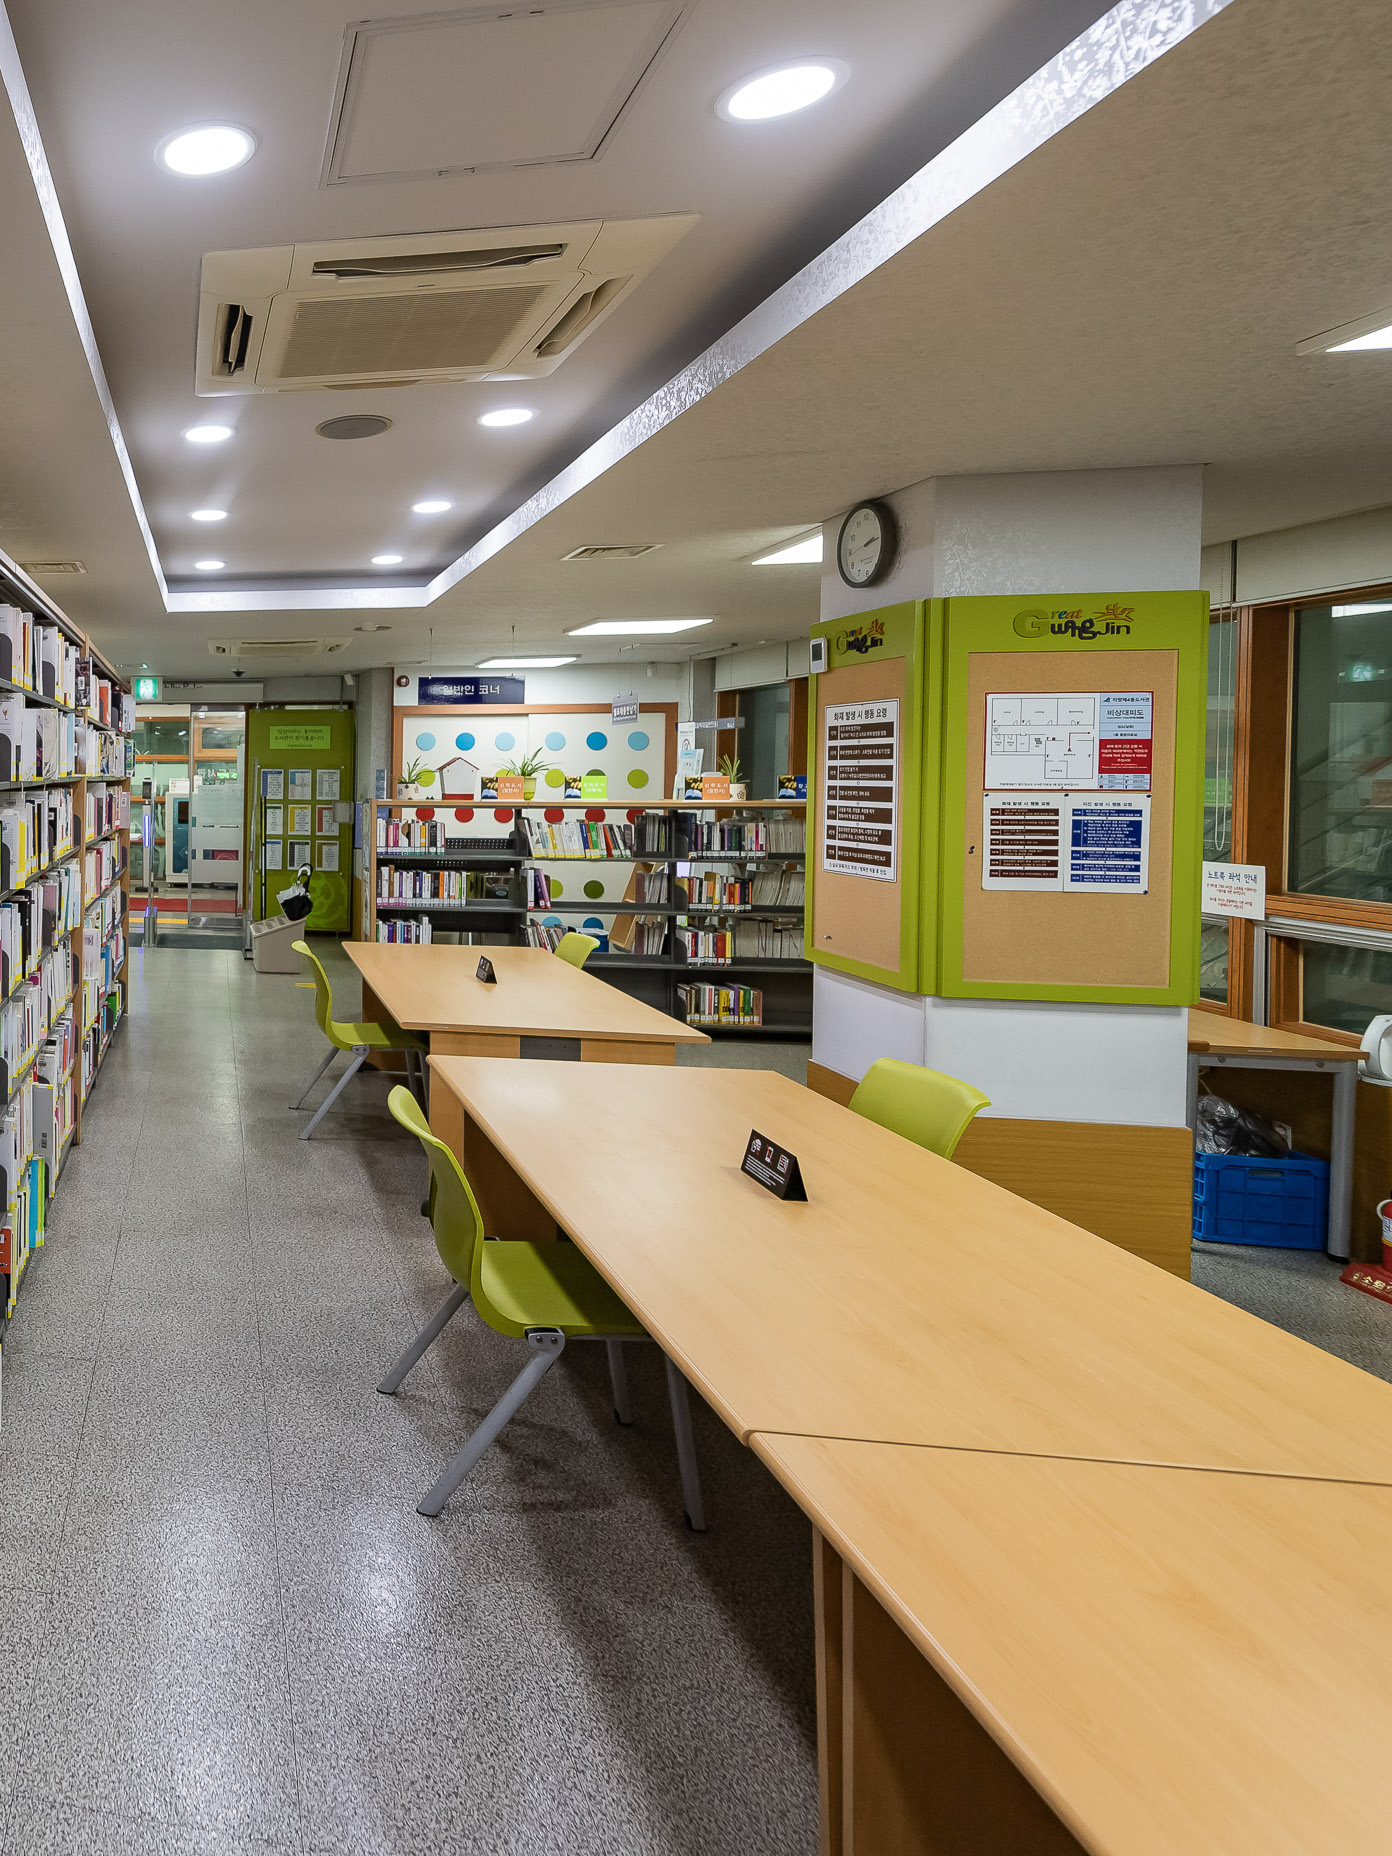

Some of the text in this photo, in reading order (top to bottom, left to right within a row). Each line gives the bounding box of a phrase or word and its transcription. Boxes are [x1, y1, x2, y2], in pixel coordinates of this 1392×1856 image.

[479, 685, 500, 695] 코너
[857, 710, 863, 719] 시
[1208, 870, 1257, 884] 노트북 좌석 안내
